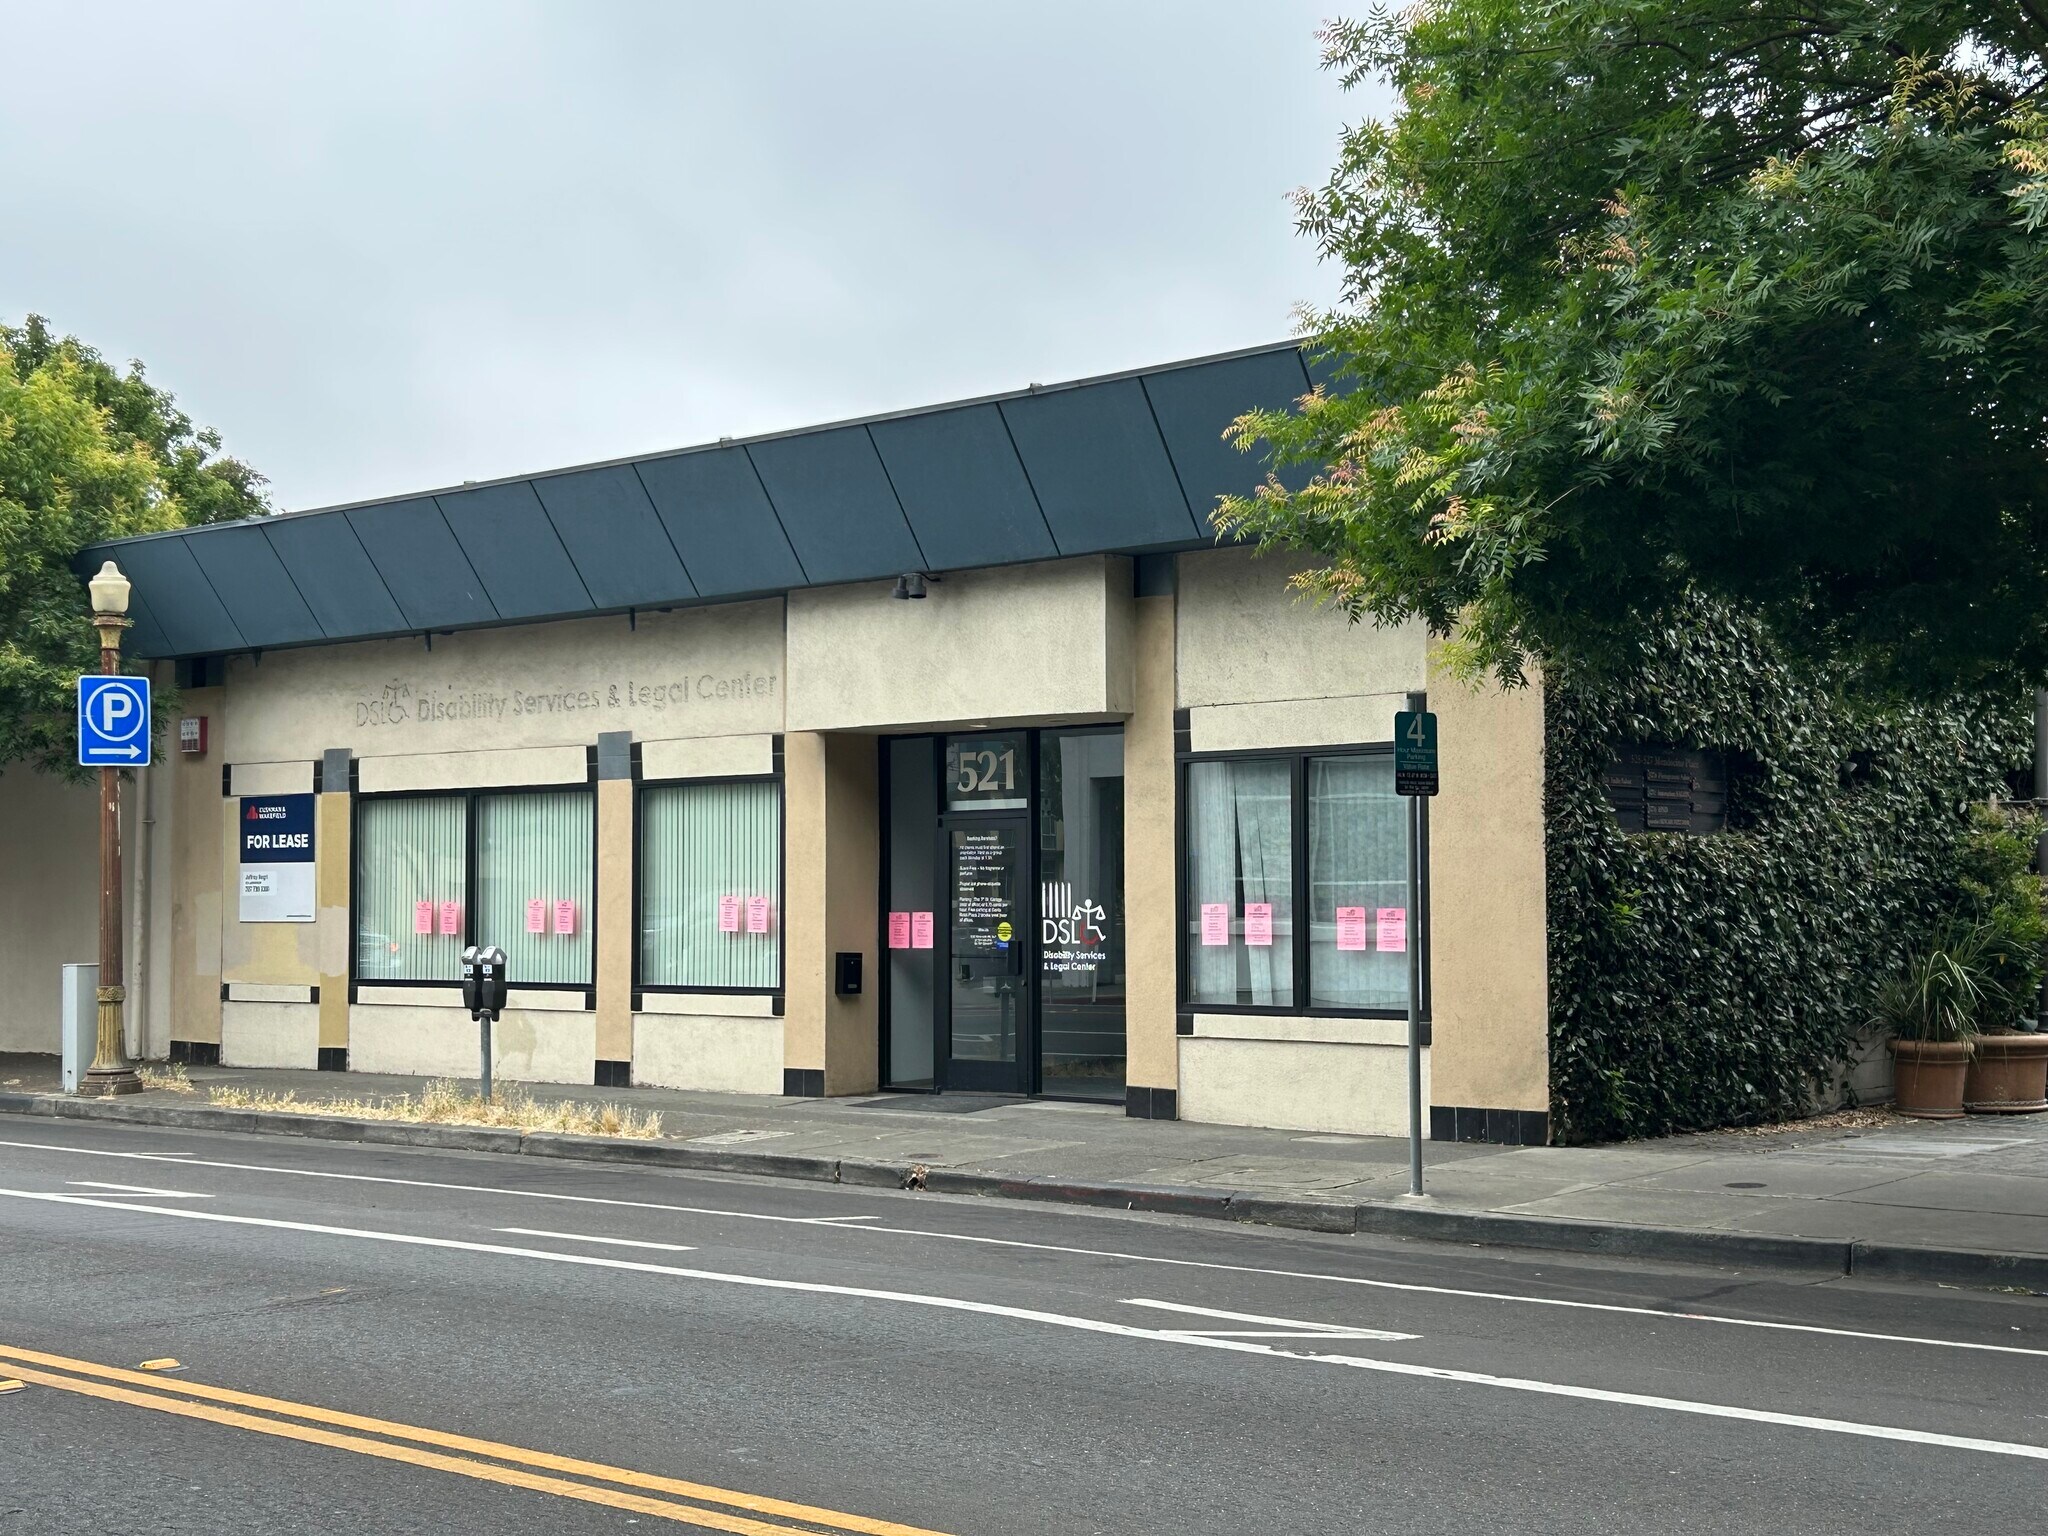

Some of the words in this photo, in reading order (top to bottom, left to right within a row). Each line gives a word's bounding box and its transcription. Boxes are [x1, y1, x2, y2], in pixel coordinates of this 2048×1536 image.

[103, 693, 132, 731] P
[418, 693, 507, 723] Disability
[513, 690, 600, 715] Services
[608, 685, 620, 708] &
[629, 676, 689, 711] Legal
[697, 672, 776, 700] Center
[1407, 713, 1425, 747] 4
[957, 749, 1014, 792] 521
[247, 834, 270, 849] FOR
[273, 833, 309, 849] LEASE
[1043, 962, 1049, 970] &
[1050, 962, 1070, 972] Legal
[1071, 962, 1096, 970] Center
[1044, 951, 1075, 960] Disability
[1076, 950, 1106, 960] Services
